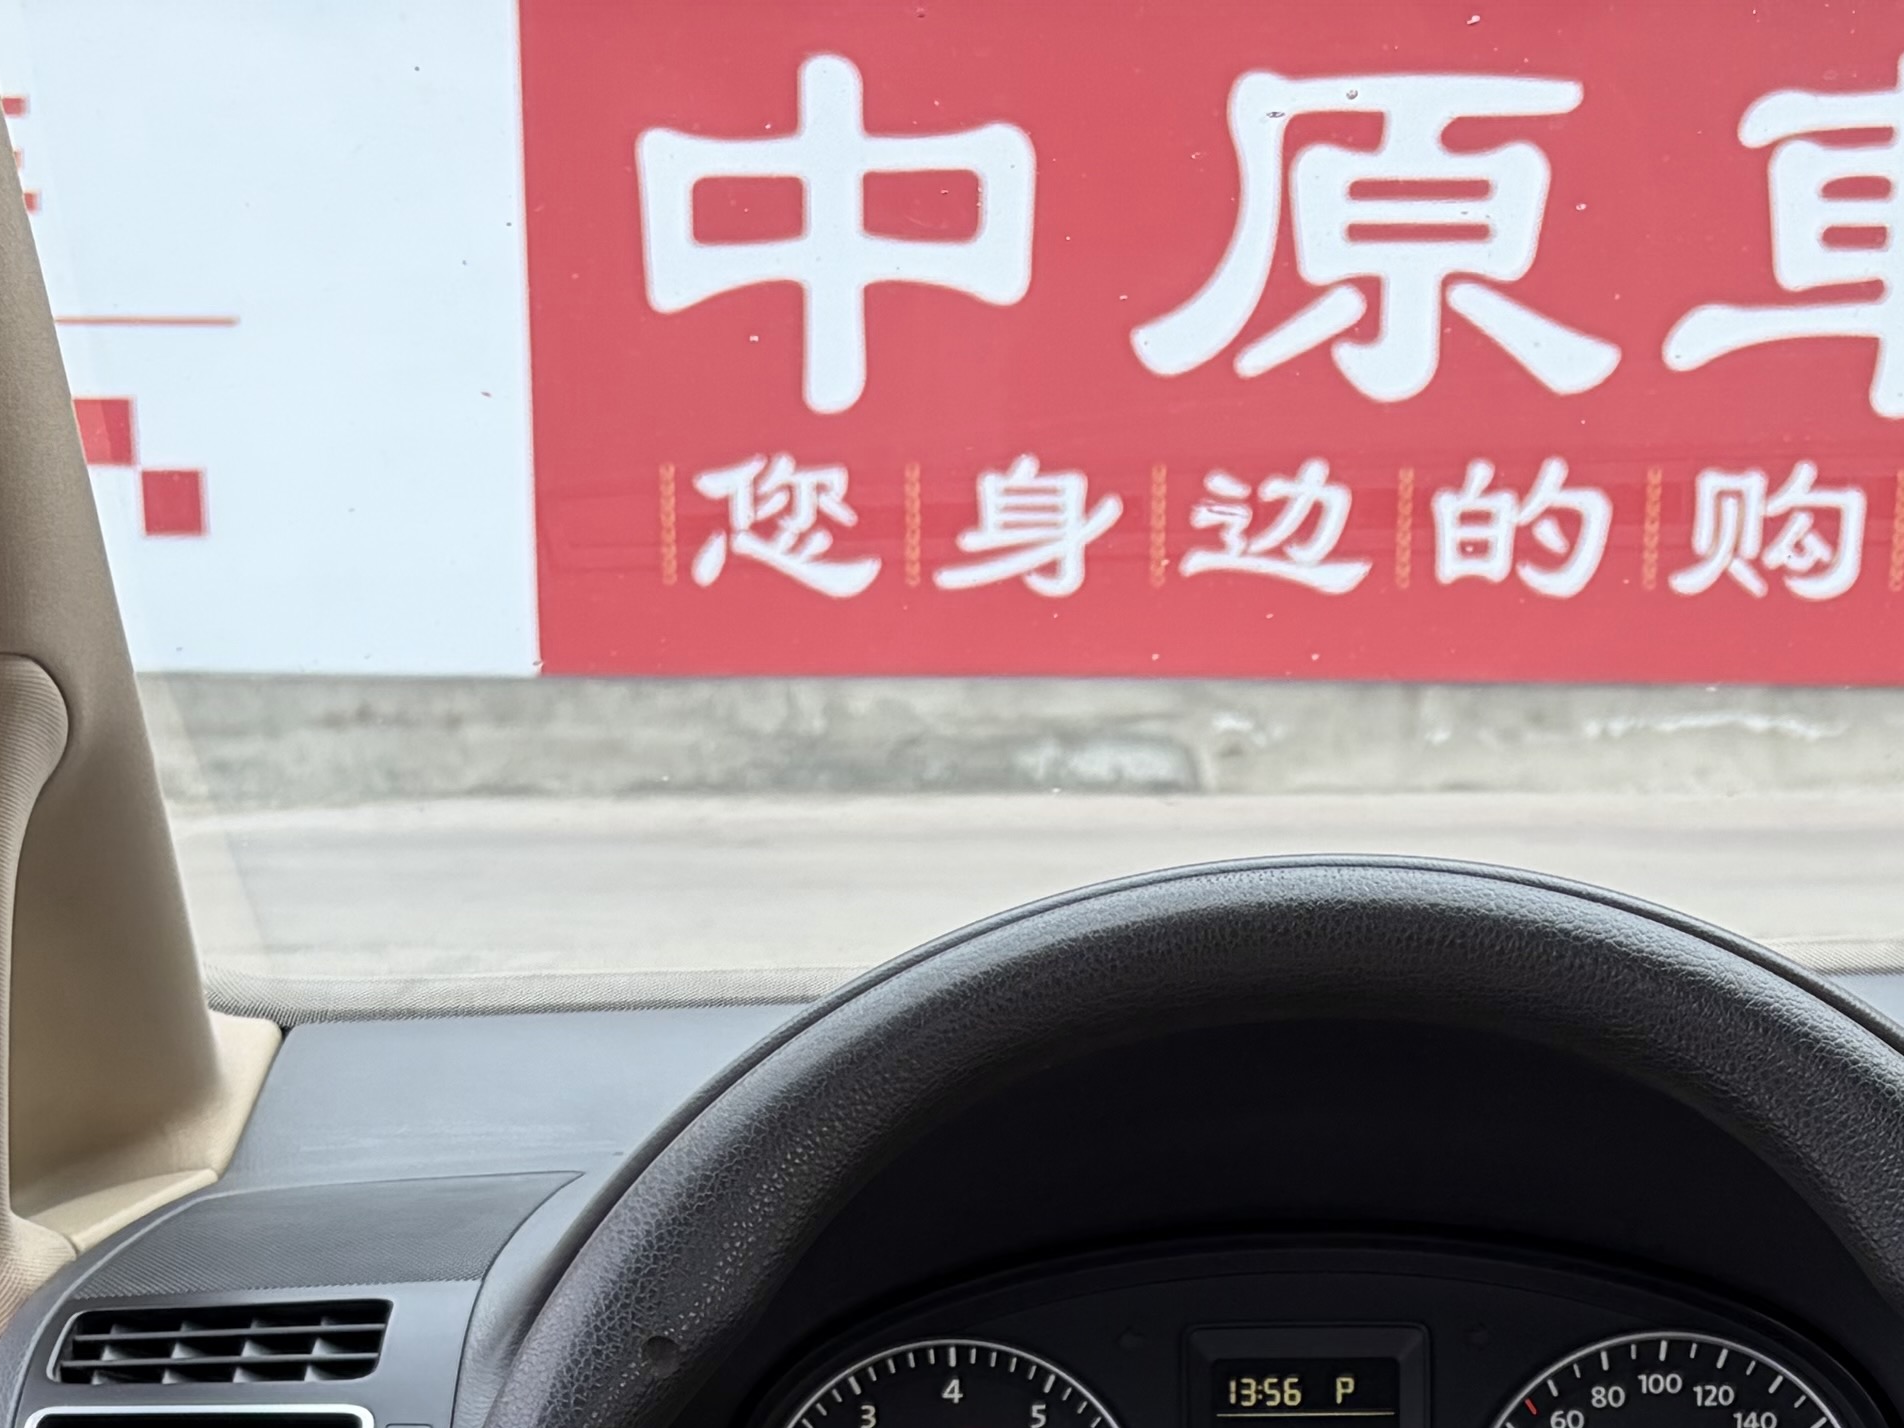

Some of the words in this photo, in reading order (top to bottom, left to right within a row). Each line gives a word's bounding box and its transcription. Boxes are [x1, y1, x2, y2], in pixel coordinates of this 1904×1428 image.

[941, 1379, 964, 1404] 4
[1228, 1377, 1302, 1407] 13:56
[1335, 1376, 1356, 1405] P
[1637, 1373, 1684, 1395] 100
[1590, 1386, 1626, 1409] 80
[1693, 1385, 1736, 1407] 120
